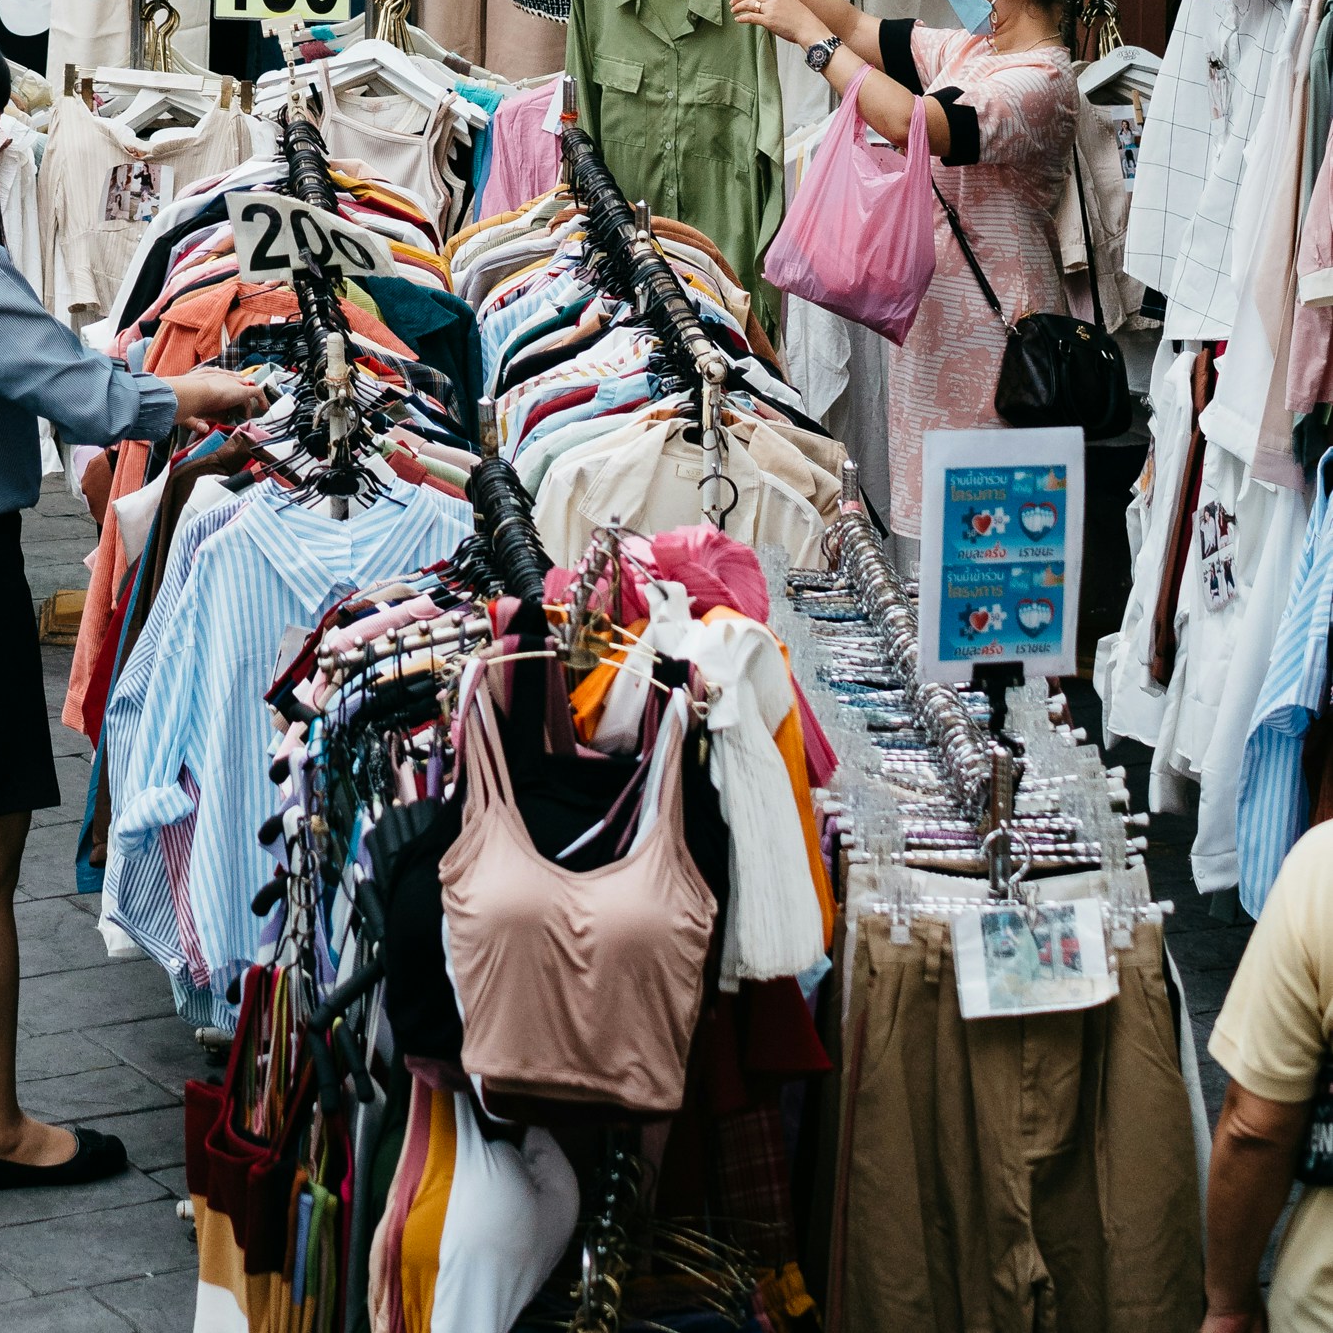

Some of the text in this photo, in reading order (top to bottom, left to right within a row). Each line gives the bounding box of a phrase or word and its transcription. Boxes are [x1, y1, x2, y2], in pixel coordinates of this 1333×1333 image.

[241, 203, 376, 272] 200
[957, 540, 1055, 560] คนละครึ่ง เราชนะ
[953, 637, 1052, 658] คนละครึ่ง เราชนะ
